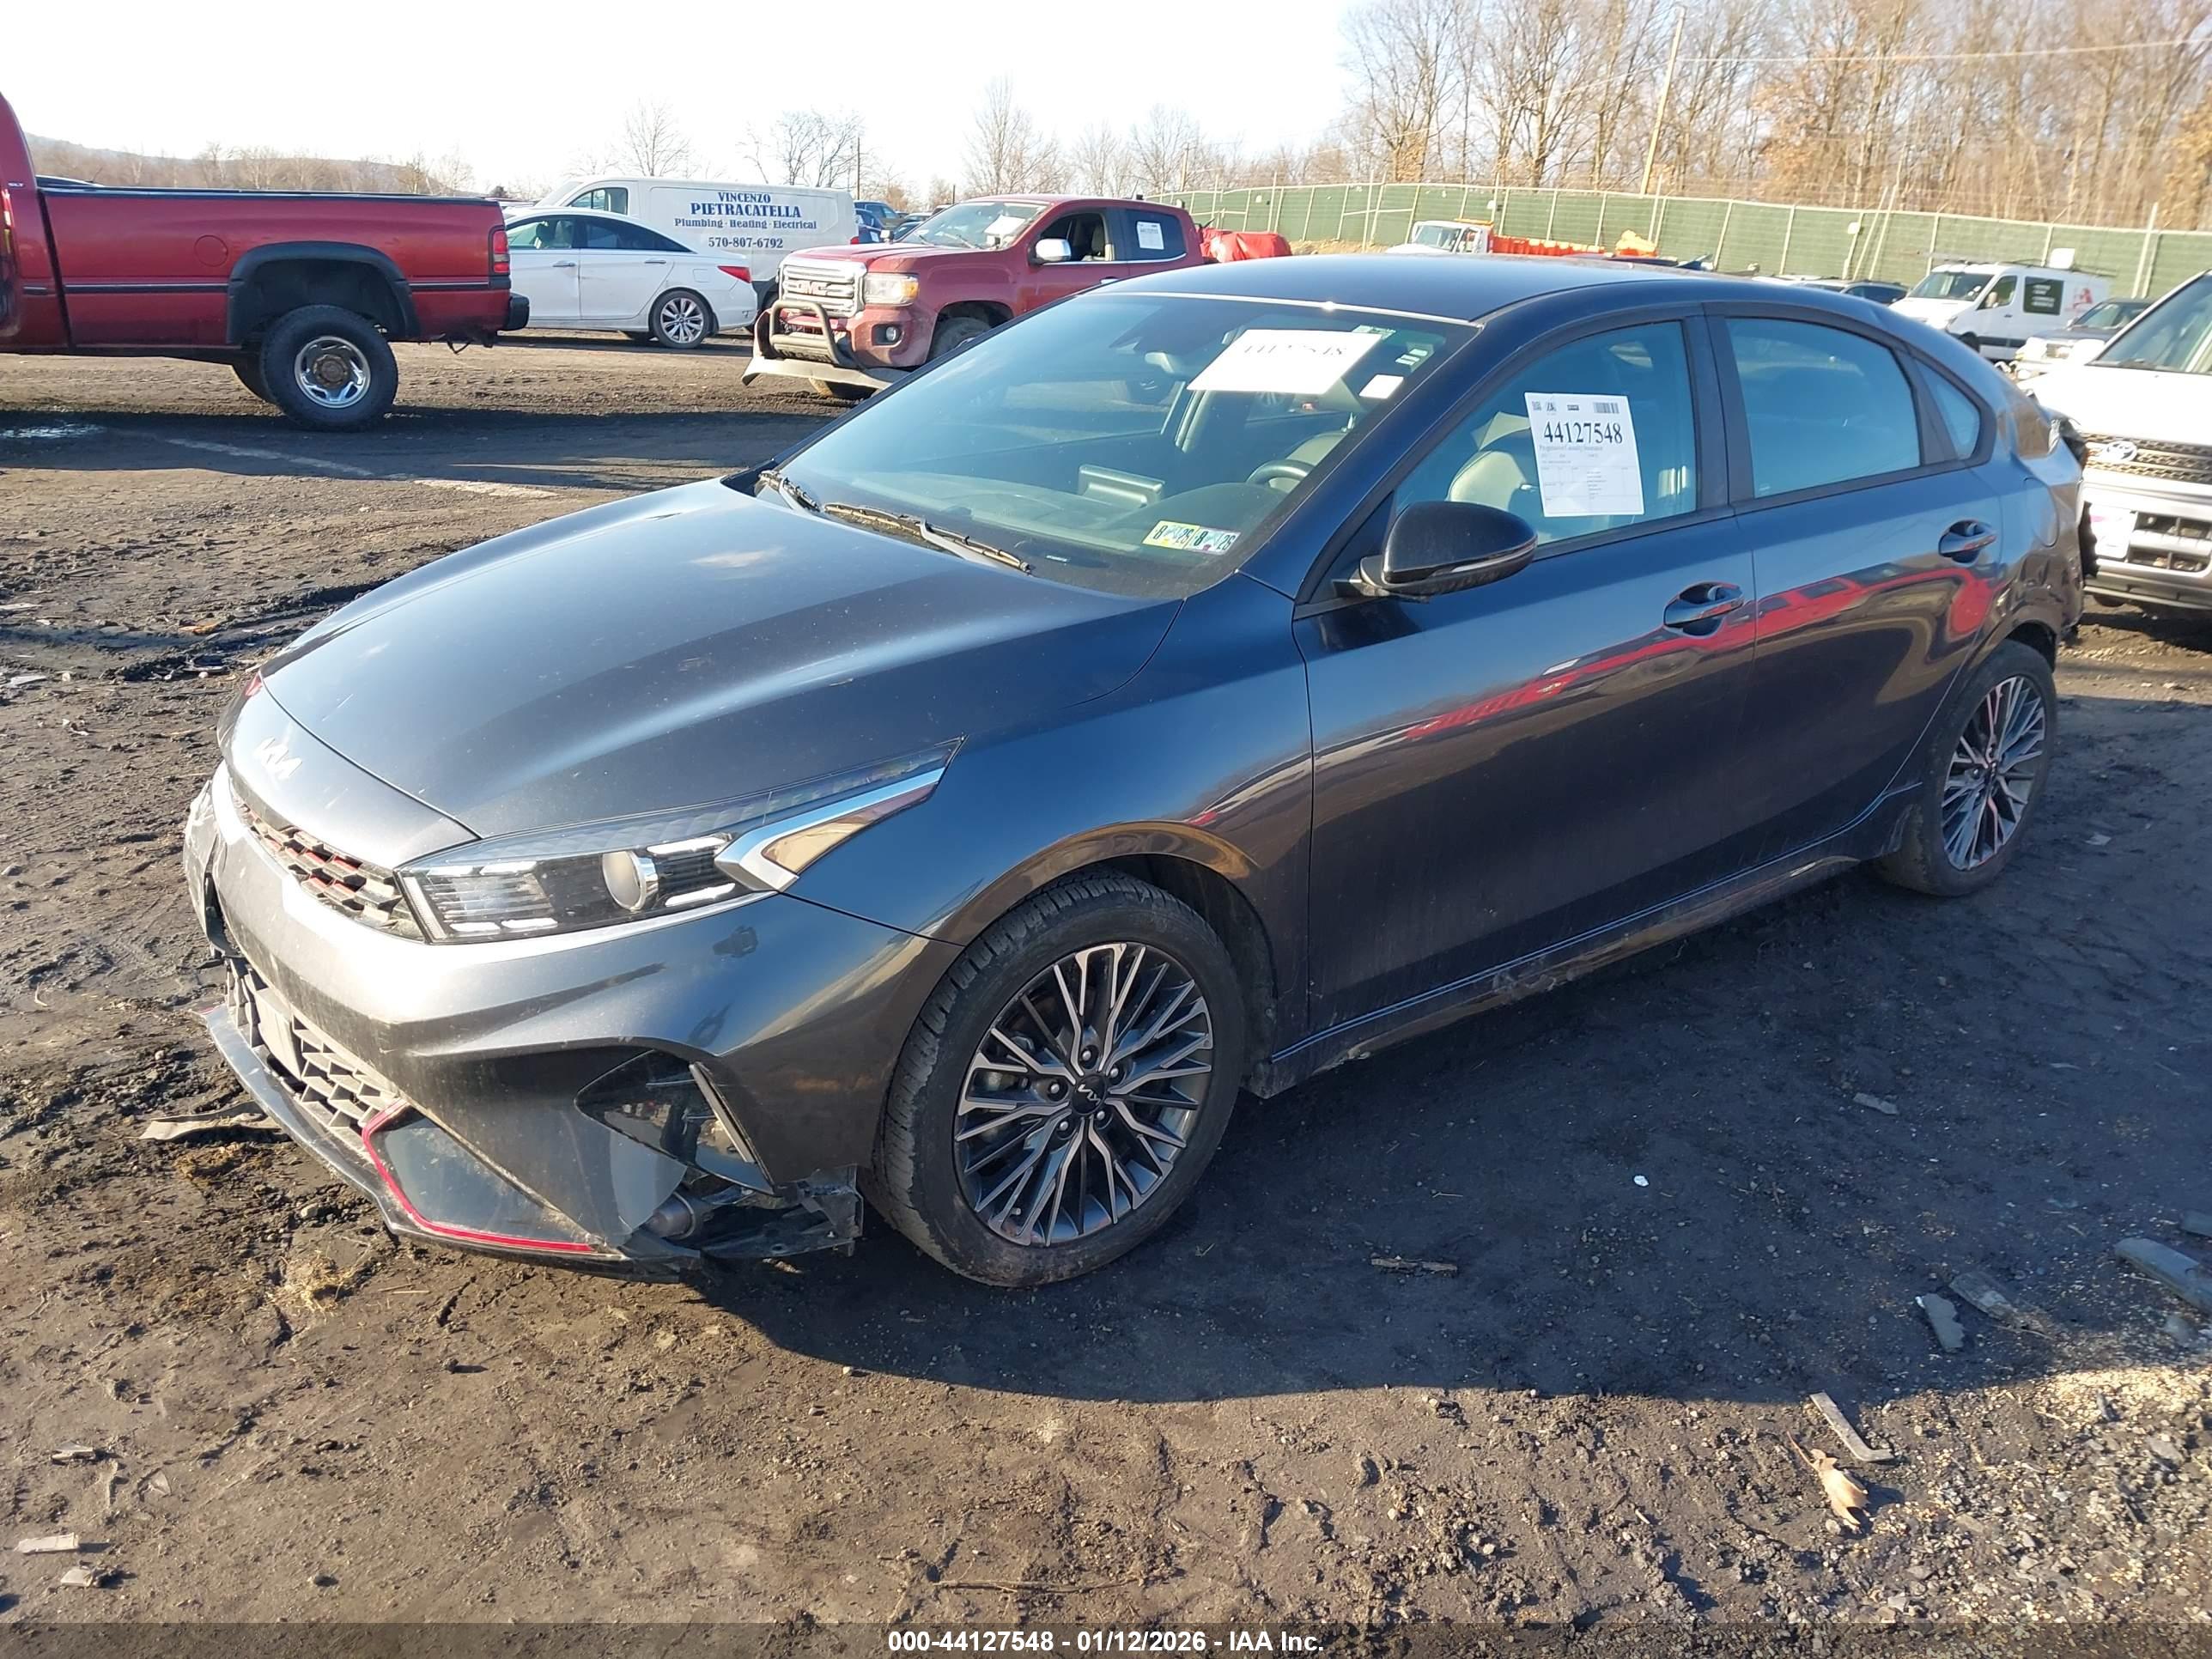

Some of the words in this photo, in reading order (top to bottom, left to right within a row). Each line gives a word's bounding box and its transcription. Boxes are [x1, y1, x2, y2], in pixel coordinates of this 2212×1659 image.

[718, 191, 771, 204] VINCENZO
[690, 203, 801, 218] PIETRACATELLA
[674, 218, 723, 228] Plumbing
[729, 220, 768, 229] Heating
[773, 220, 817, 229] Electrical
[708, 237, 783, 249] 570-807-6792
[1543, 421, 1623, 444] 44127548
